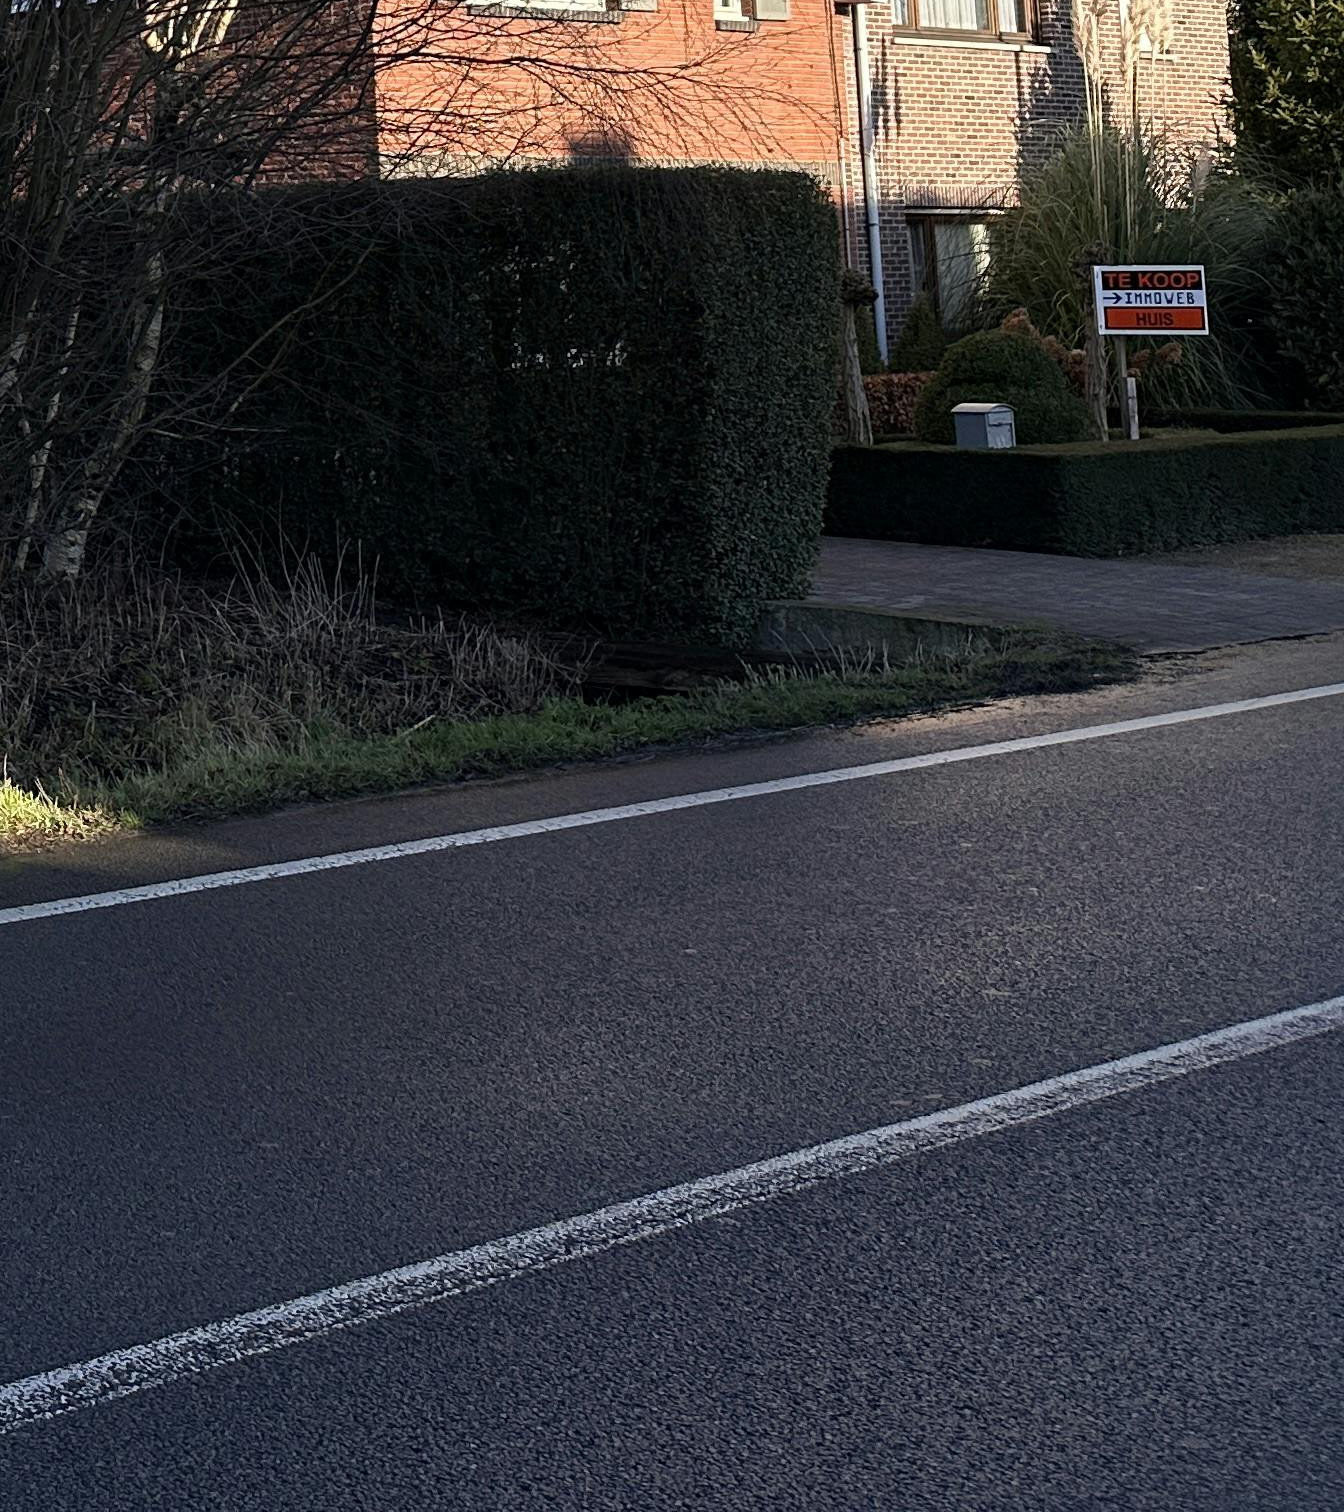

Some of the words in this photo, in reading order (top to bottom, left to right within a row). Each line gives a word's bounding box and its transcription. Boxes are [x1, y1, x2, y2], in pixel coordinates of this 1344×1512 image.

[1104, 273, 1131, 288] TE
[1138, 272, 1200, 288] KOOP
[1125, 292, 1195, 305] IMMOWEB
[1136, 312, 1174, 326] HUIS
